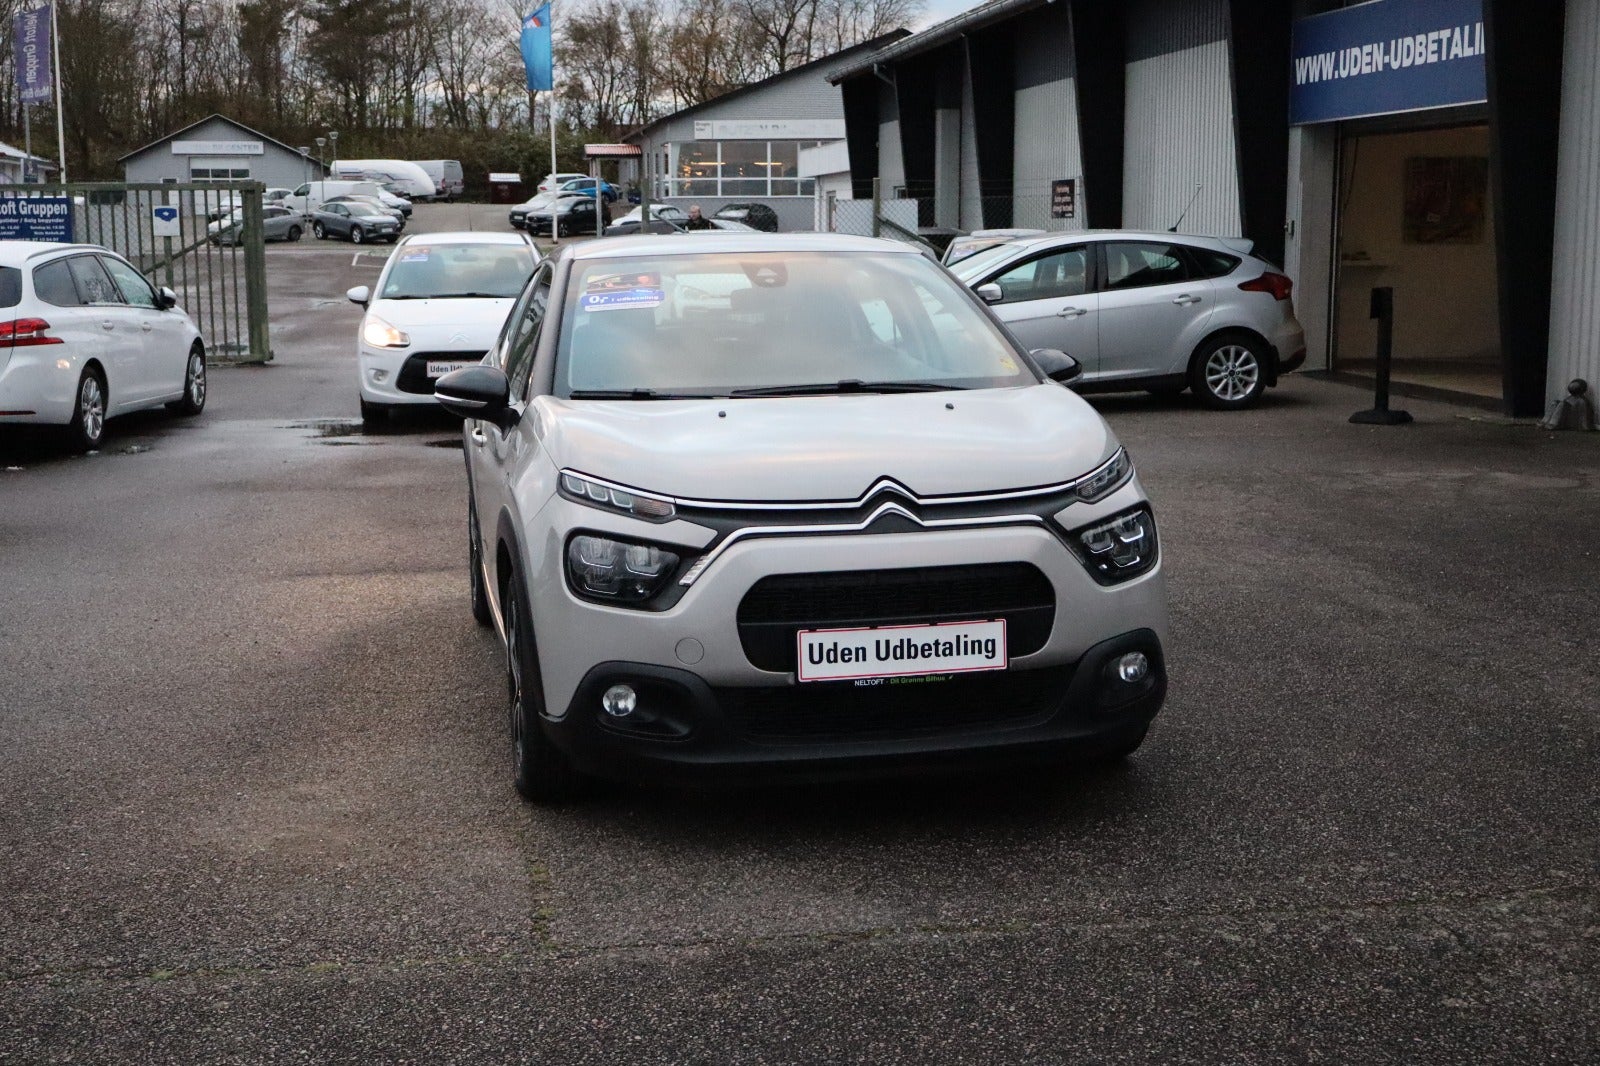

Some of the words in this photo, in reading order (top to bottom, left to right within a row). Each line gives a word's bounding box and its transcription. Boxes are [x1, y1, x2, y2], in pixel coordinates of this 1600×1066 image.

[0, 200, 17, 215] oft
[18, 200, 68, 218] Gruppen
[430, 365, 449, 373] Uden
[808, 642, 867, 665] Uden
[875, 634, 996, 661] Udbetaling
[854, 678, 884, 687] NELTOFT
